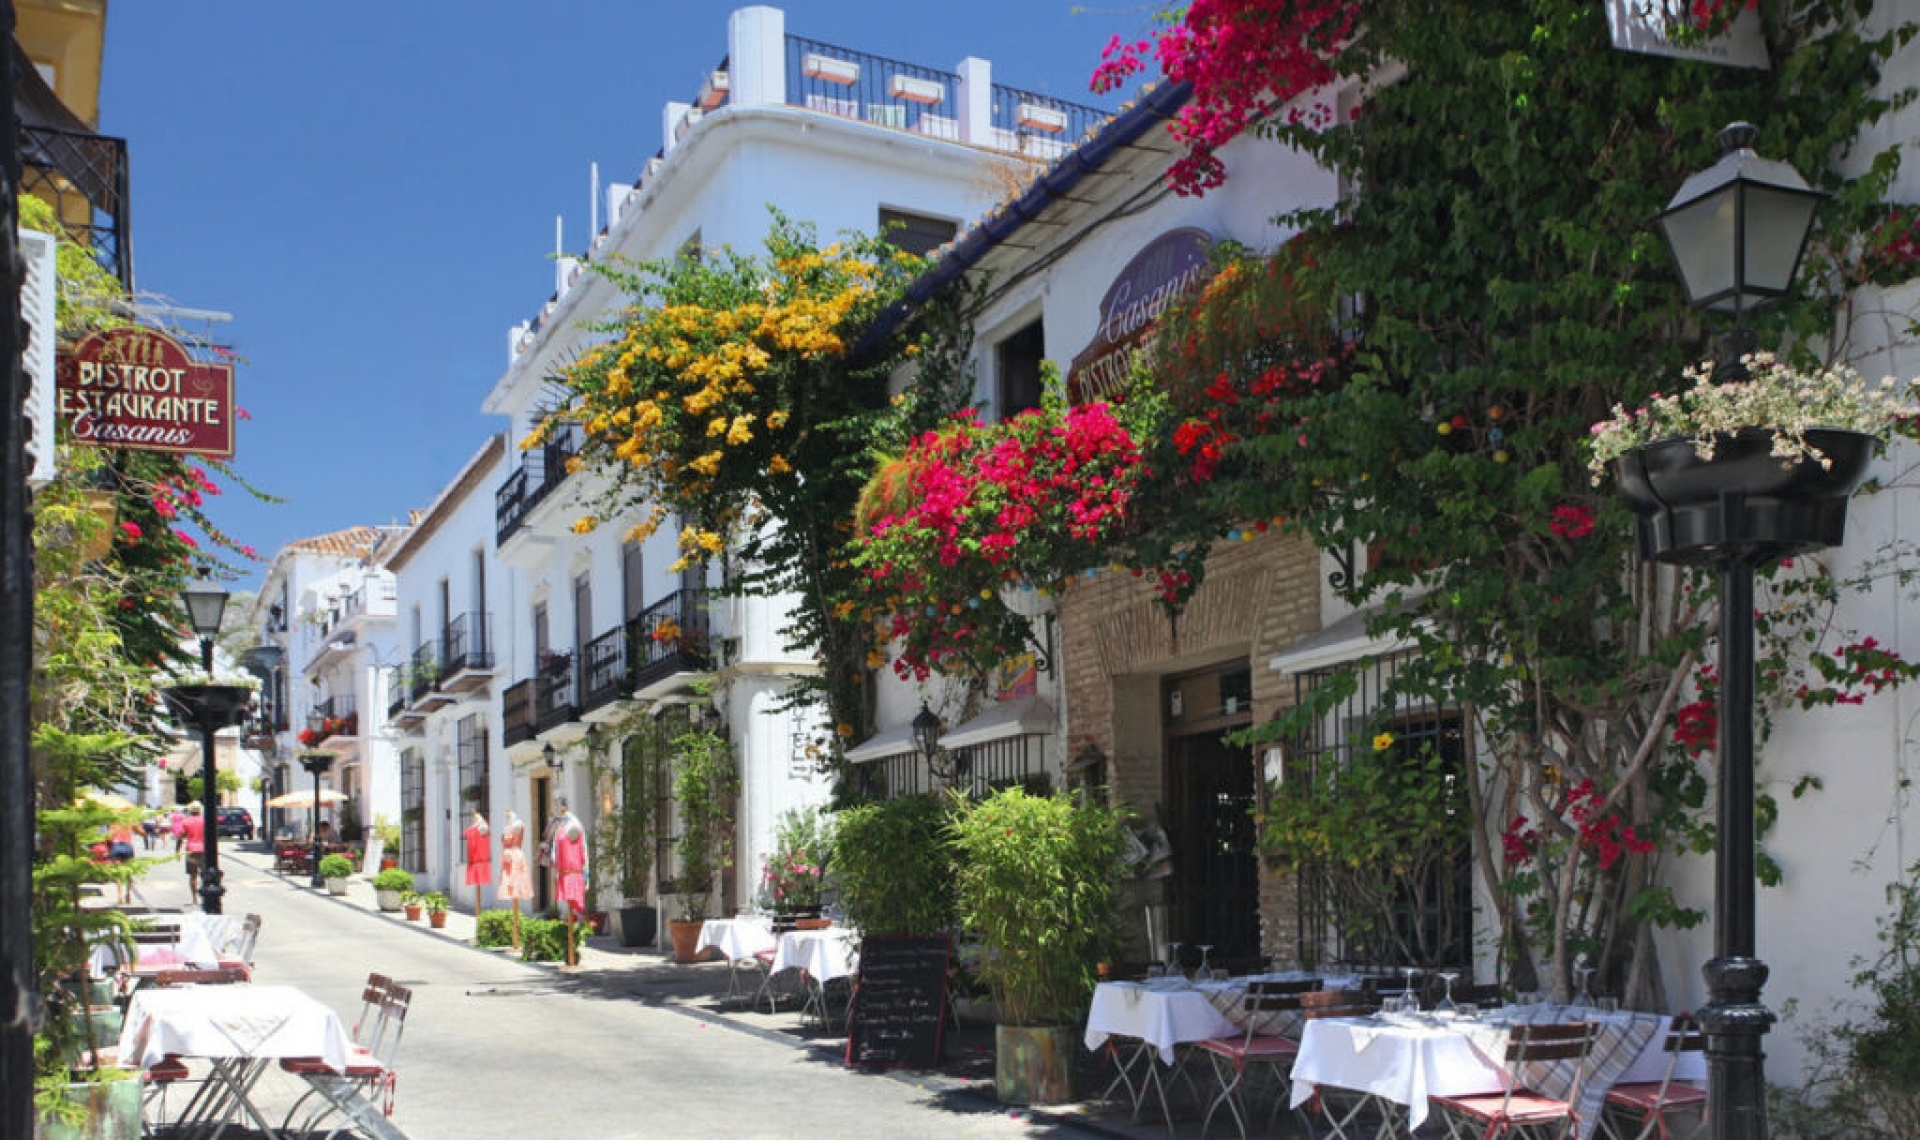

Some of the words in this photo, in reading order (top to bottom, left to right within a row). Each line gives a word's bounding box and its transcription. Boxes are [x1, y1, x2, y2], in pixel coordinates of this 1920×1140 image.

[79, 361, 187, 394] BISTROT
[58, 387, 221, 425] ESTAURANTE
[71, 410, 195, 445] Casanis
